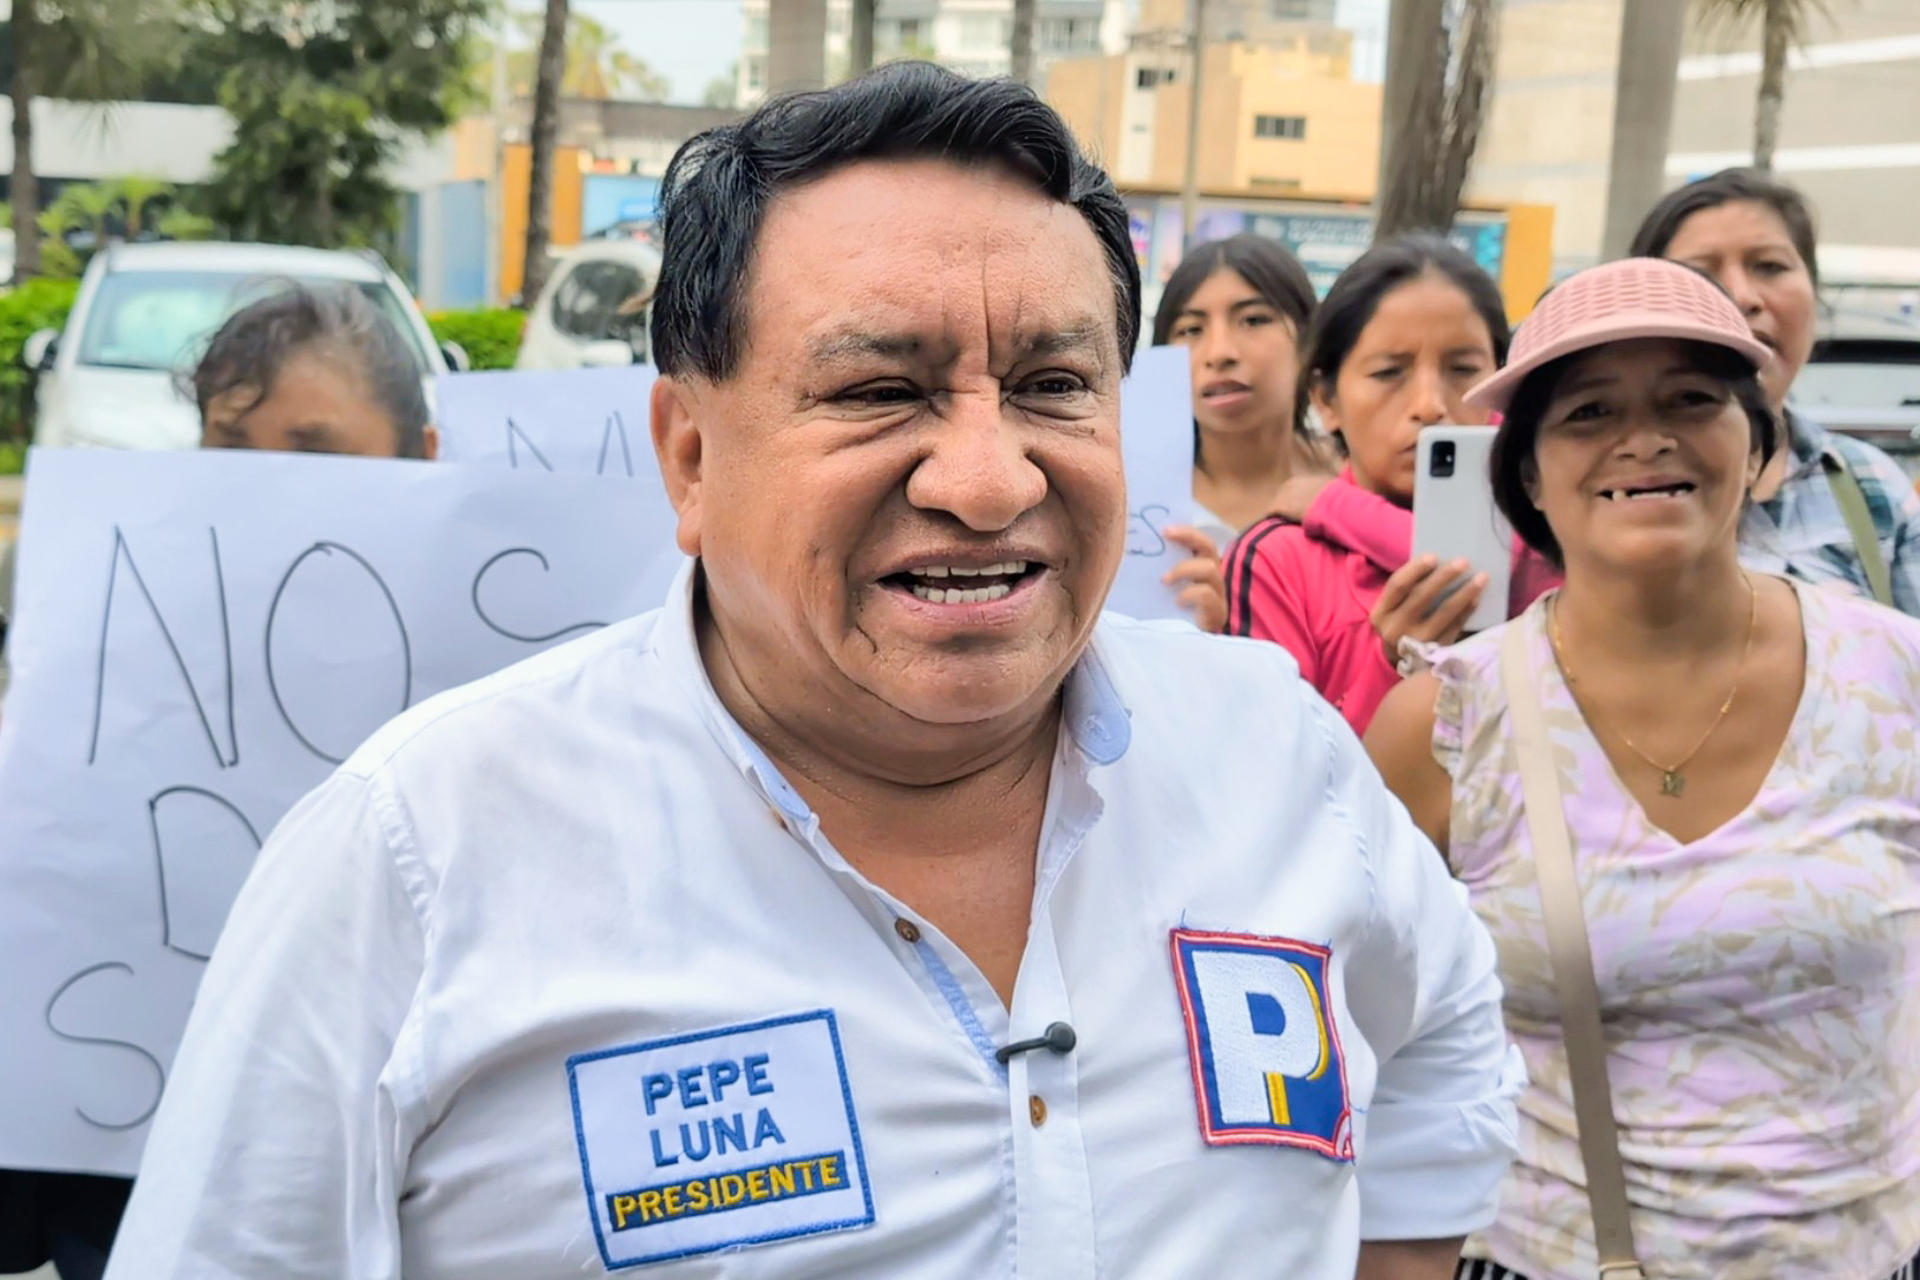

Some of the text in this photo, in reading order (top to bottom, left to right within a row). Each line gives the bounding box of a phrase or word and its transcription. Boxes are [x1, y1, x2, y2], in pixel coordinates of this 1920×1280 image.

[89, 524, 412, 768] NO
[1191, 950, 1329, 1126] P
[641, 1052, 775, 1116] PEPE
[649, 1107, 787, 1168] LUNA
[613, 1156, 841, 1229] PRESIDENTE
